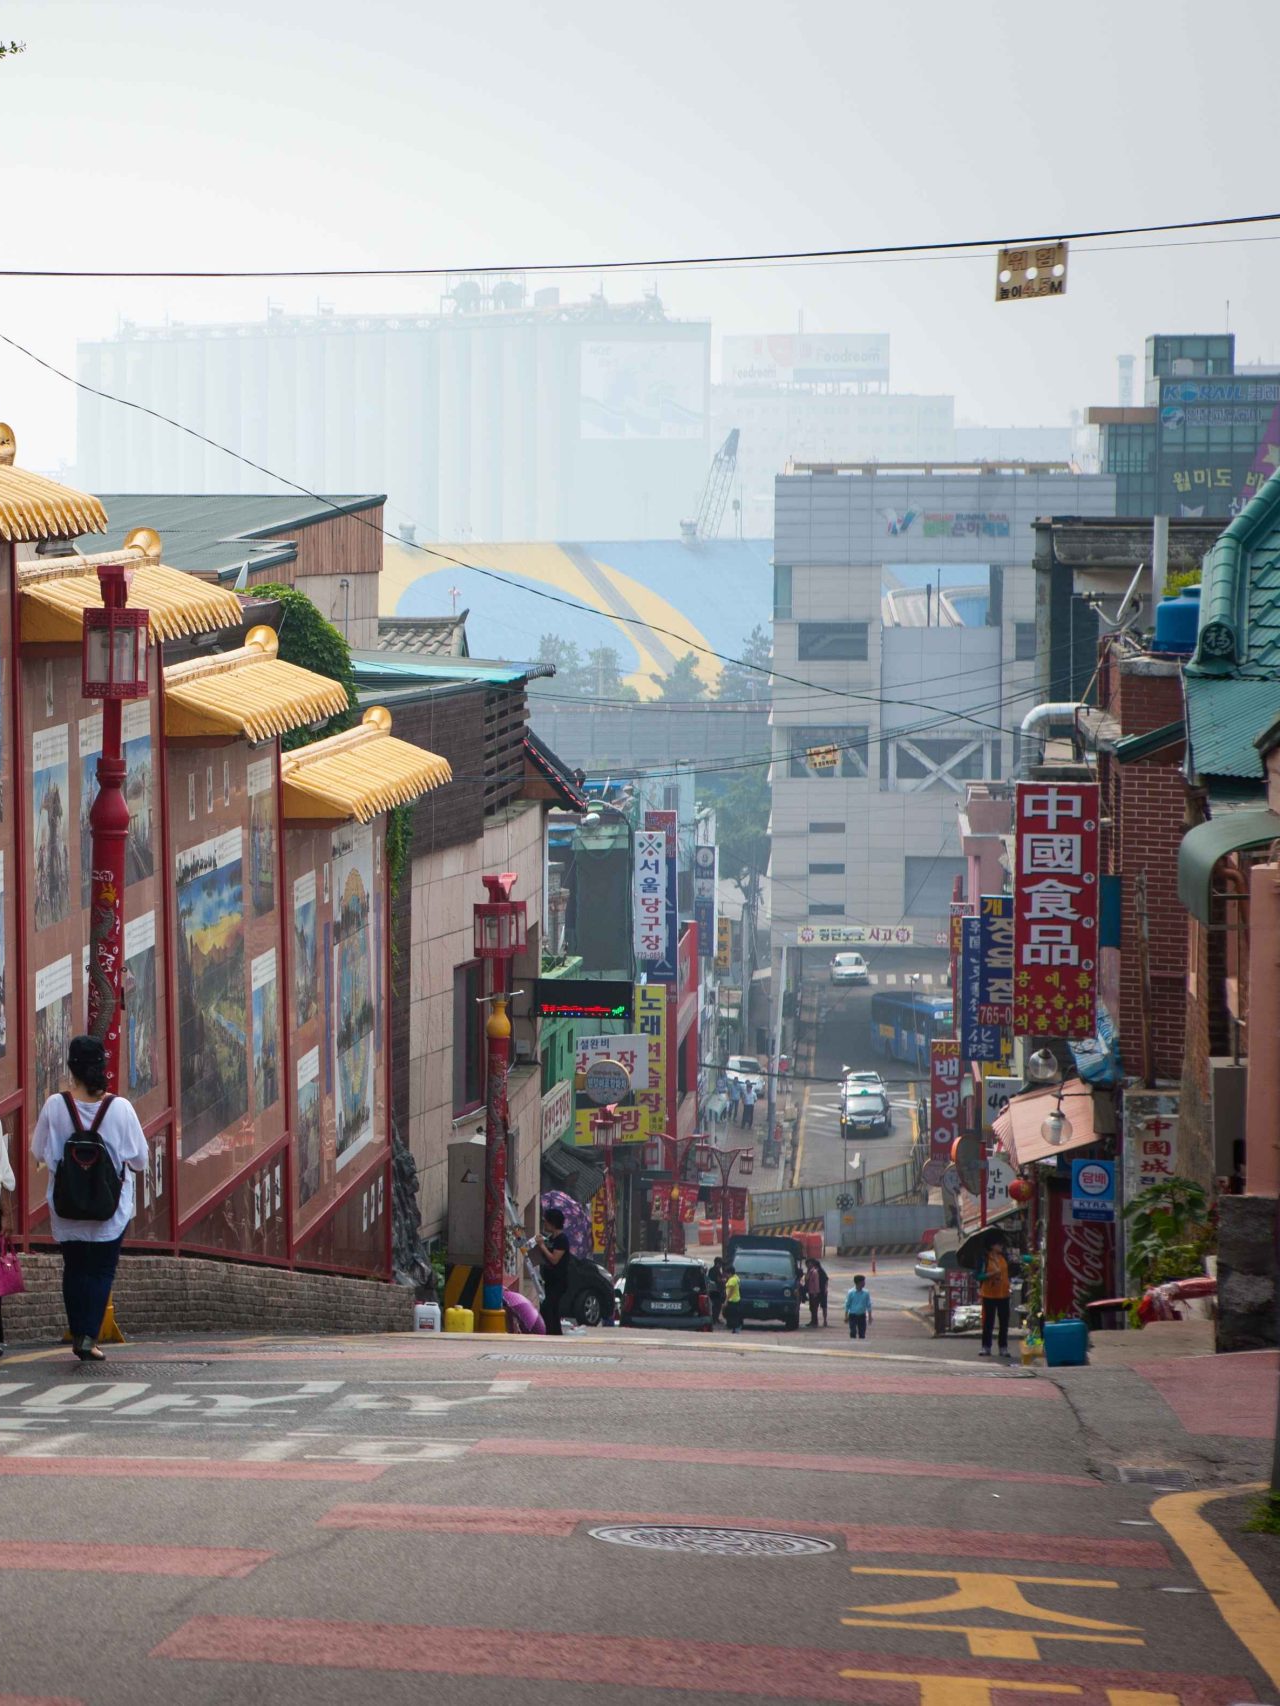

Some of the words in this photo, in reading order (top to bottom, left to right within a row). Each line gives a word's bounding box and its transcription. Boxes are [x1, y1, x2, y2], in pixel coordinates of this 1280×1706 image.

[1173, 469, 1232, 492] 월미도
[639, 859, 663, 951] 서울당구장
[1022, 787, 1083, 966] 中國食品
[1140, 1115, 1174, 1176] 中國城
[1081, 1171, 1107, 1185] 담배
